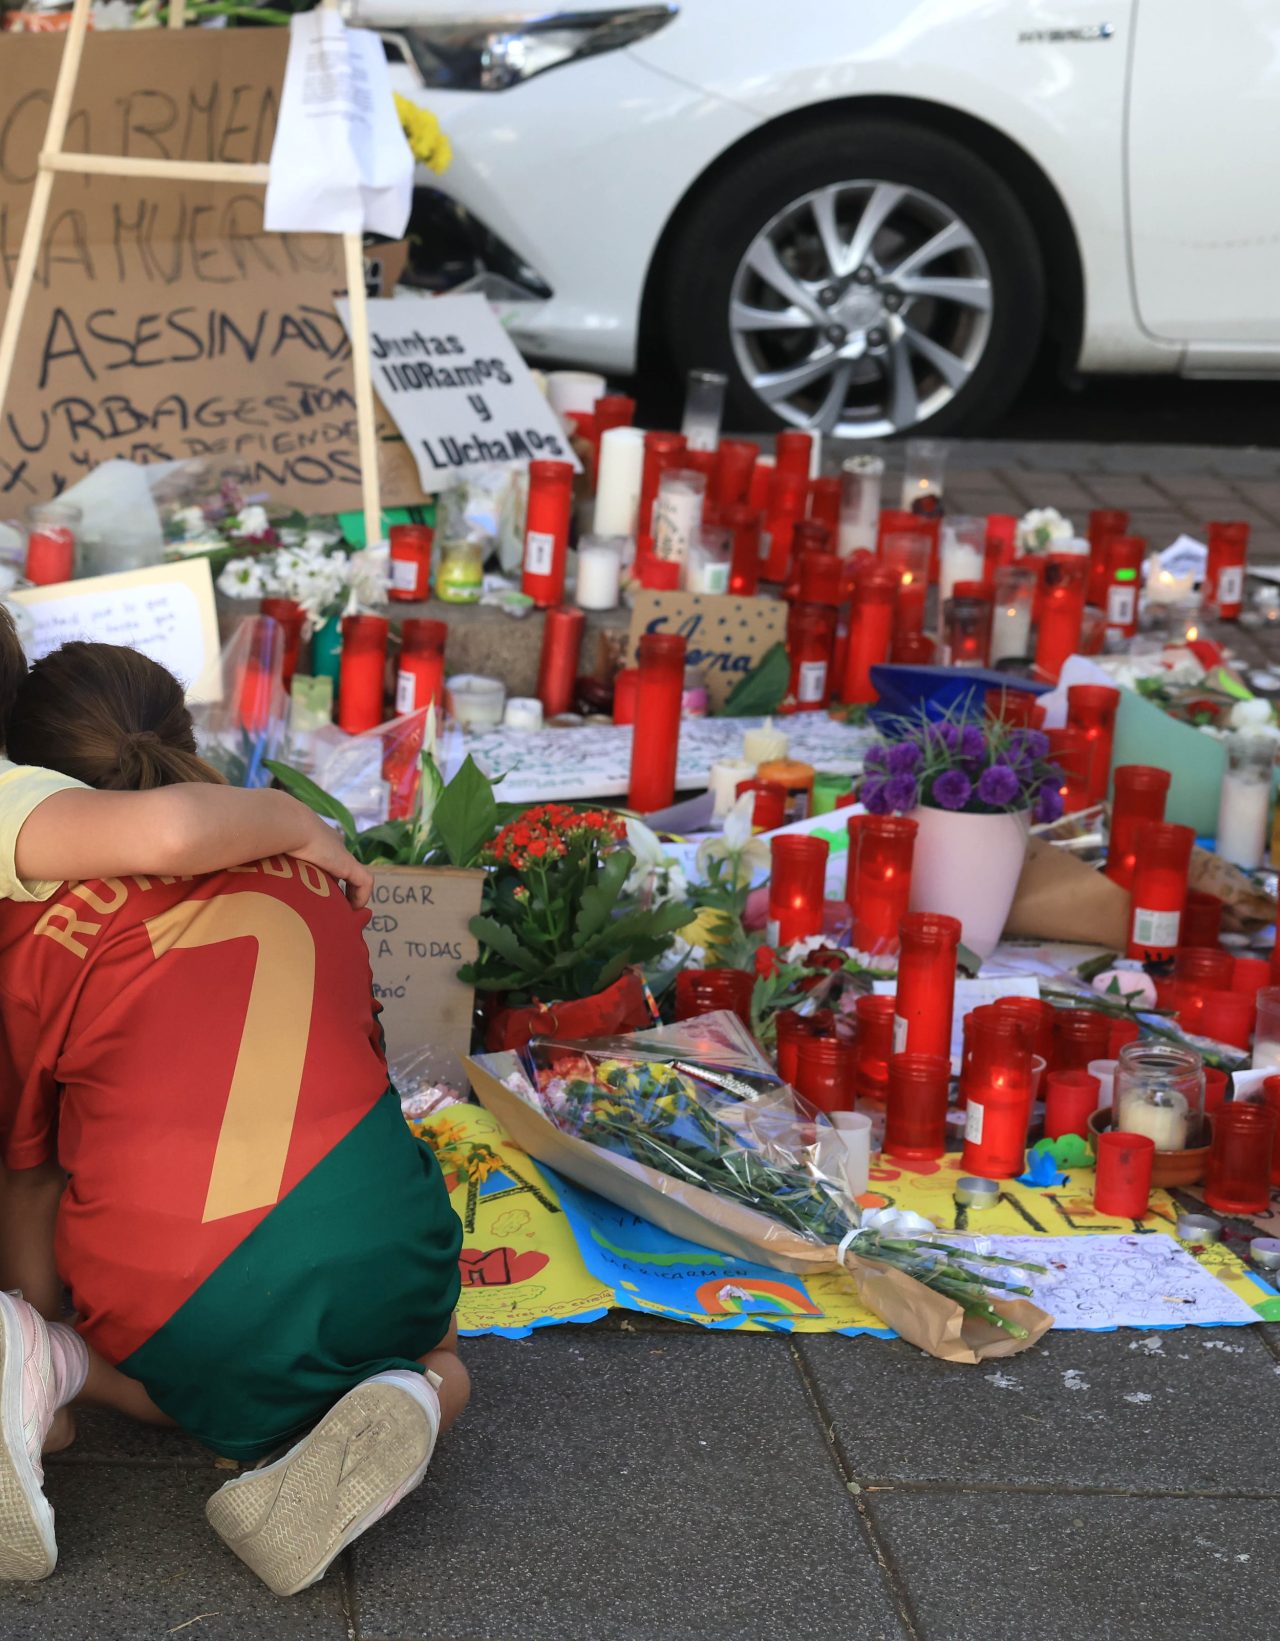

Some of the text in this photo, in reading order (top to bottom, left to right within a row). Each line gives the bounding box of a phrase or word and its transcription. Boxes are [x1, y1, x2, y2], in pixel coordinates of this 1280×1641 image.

[37, 305, 354, 390] ASESINAD
[33, 857, 331, 961] RODO
[378, 938, 463, 961] A TODAS
[142, 890, 316, 1225] 7
